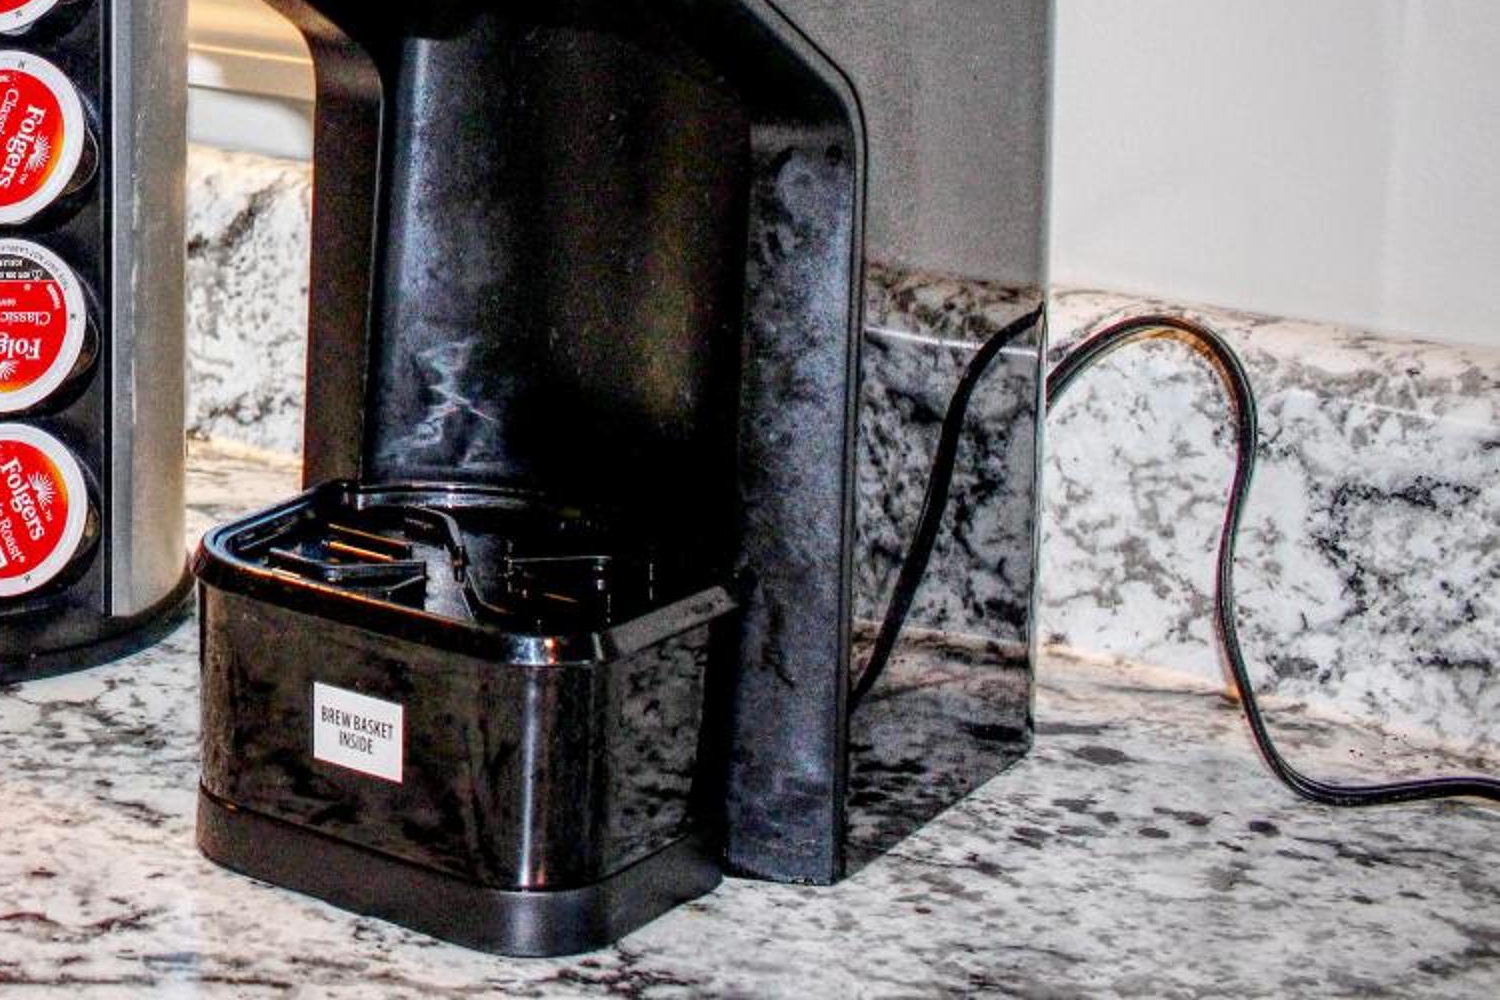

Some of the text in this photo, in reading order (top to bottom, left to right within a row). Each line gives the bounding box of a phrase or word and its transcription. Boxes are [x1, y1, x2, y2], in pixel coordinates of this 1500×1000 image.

[0, 311, 51, 326] Classic
[0, 457, 45, 541] Folgers
[321, 704, 393, 740] BREW BASKET
[339, 731, 373, 755] INSIDE
